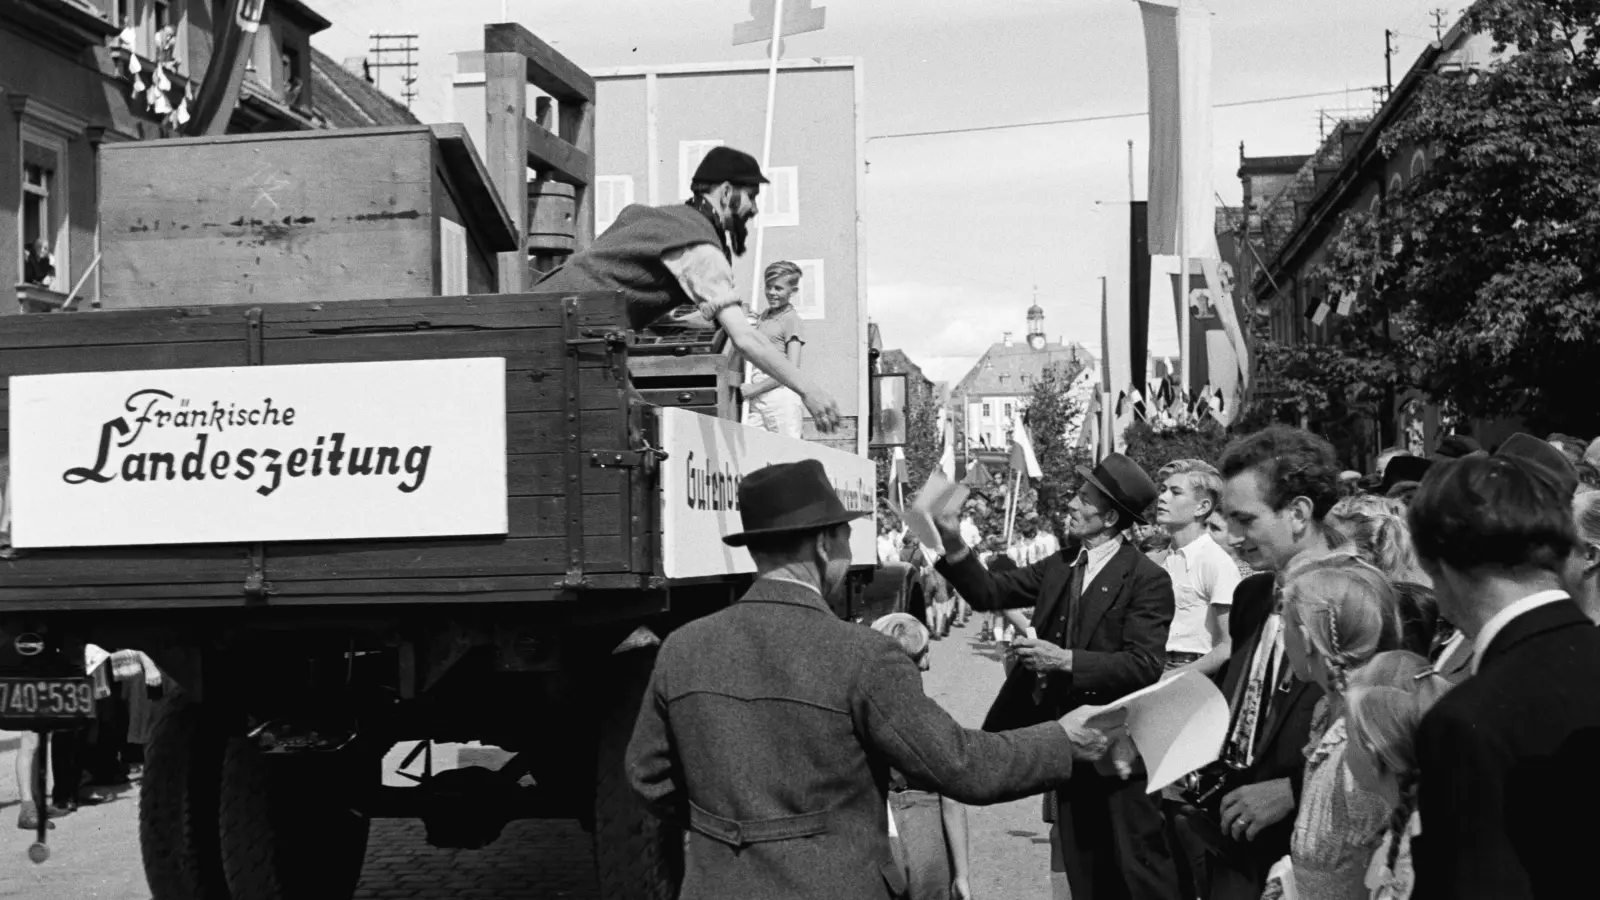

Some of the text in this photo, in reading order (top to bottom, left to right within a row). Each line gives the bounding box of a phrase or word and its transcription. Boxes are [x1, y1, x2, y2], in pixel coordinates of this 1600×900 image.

[118, 388, 296, 447] Fränkische
[63, 416, 432, 496] Landeszeitung
[686, 450, 743, 511] Gutenbe
